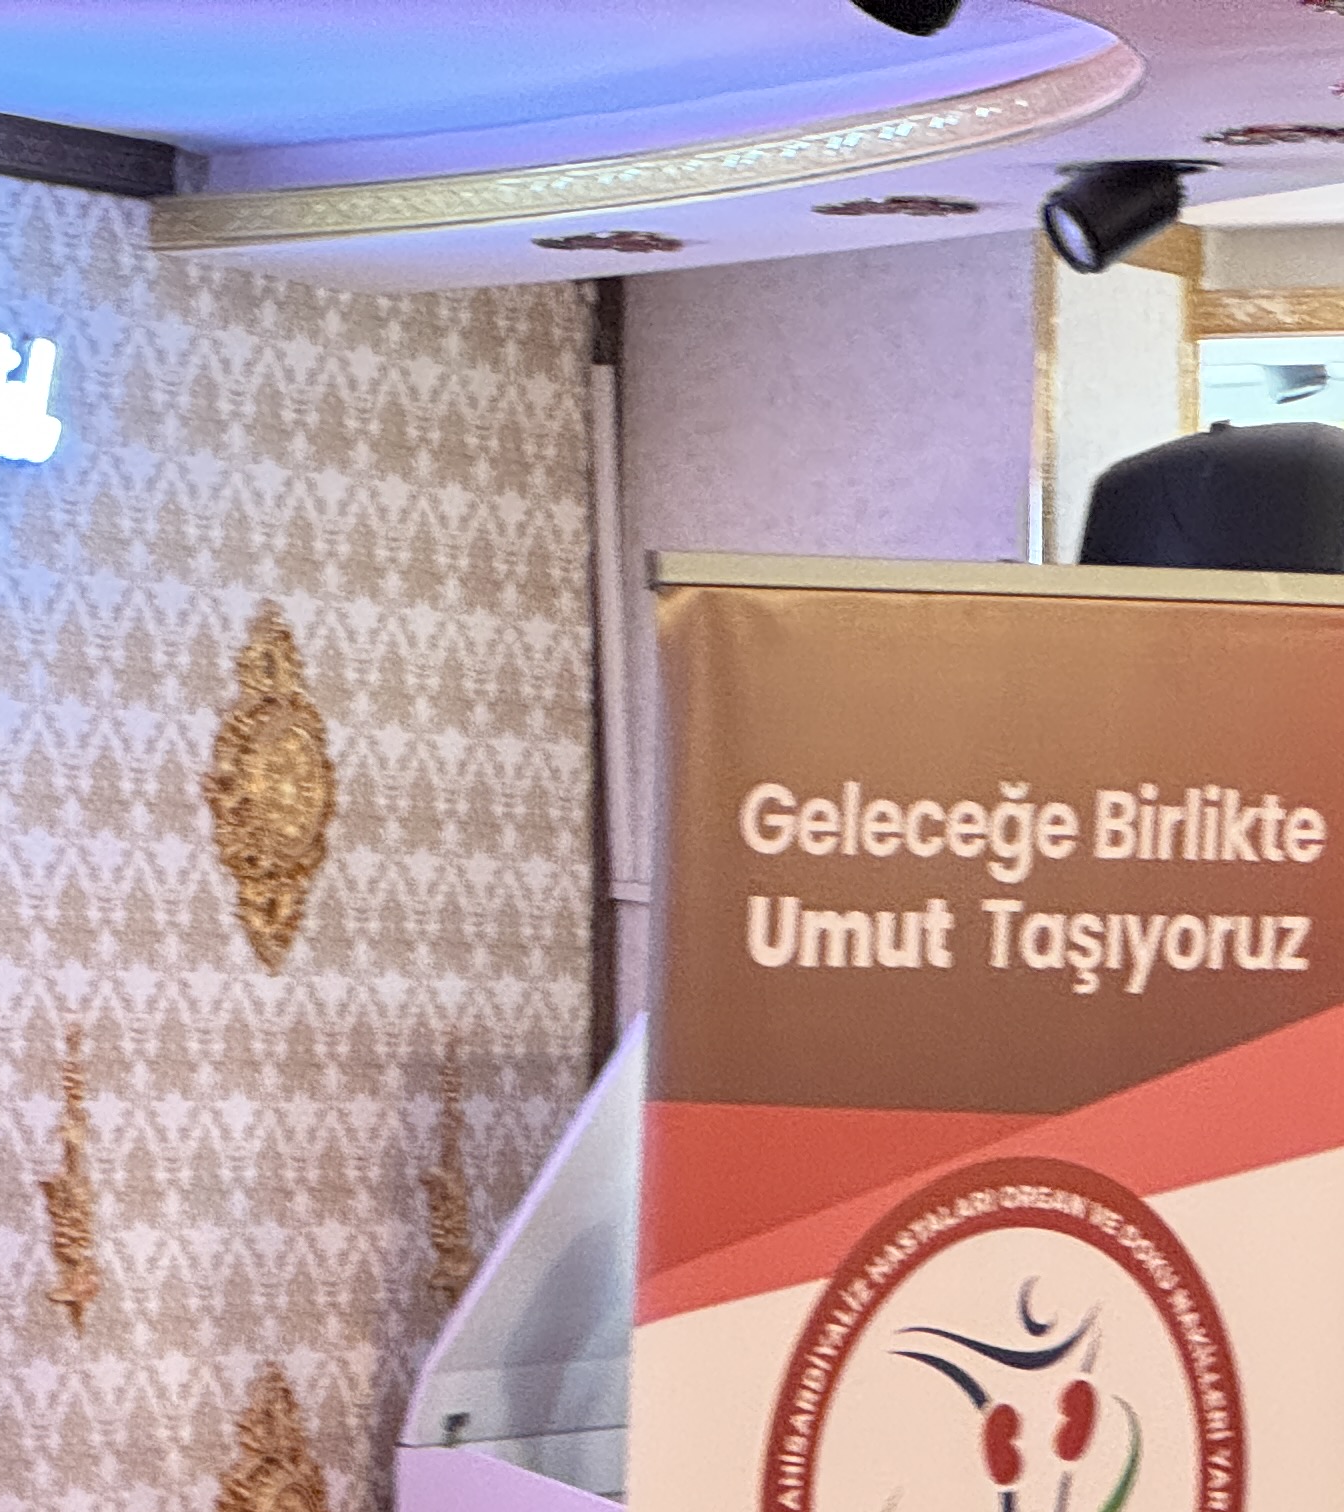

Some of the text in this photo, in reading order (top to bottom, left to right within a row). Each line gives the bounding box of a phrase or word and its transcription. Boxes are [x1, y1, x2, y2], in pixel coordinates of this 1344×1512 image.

[740, 781, 1327, 883] Geleceğe Birlikte
[746, 896, 1312, 994] Umut Taşıyoruz
